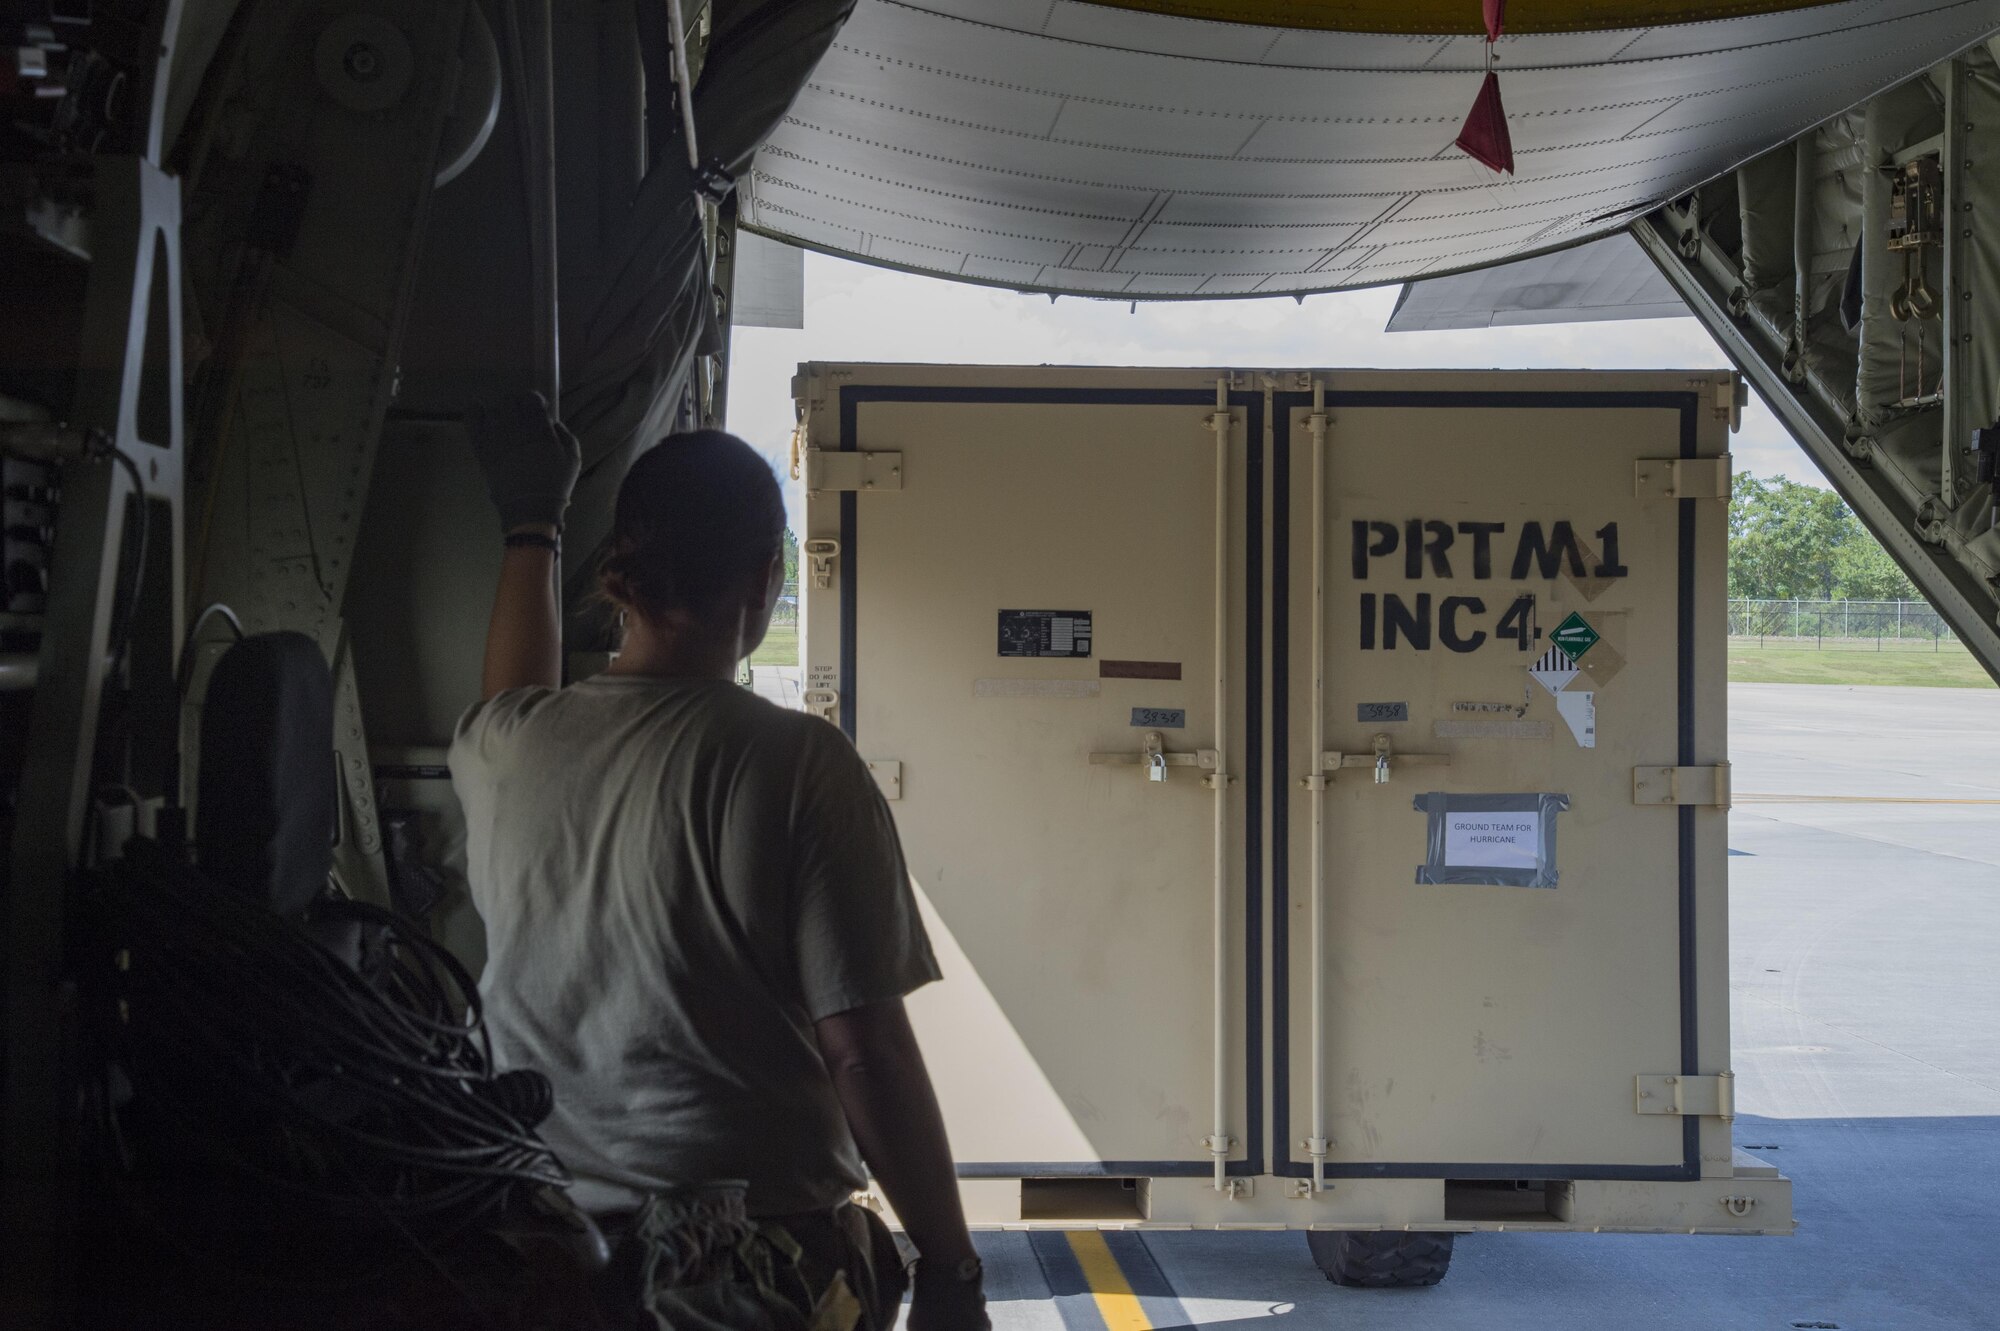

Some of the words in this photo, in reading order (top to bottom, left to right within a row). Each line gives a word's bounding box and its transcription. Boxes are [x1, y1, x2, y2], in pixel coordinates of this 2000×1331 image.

[1142, 708, 1180, 725] 3838
[1365, 702, 1403, 718] 3838
[1454, 823, 1489, 831] GROUND
[1492, 823, 1514, 831] TEAM
